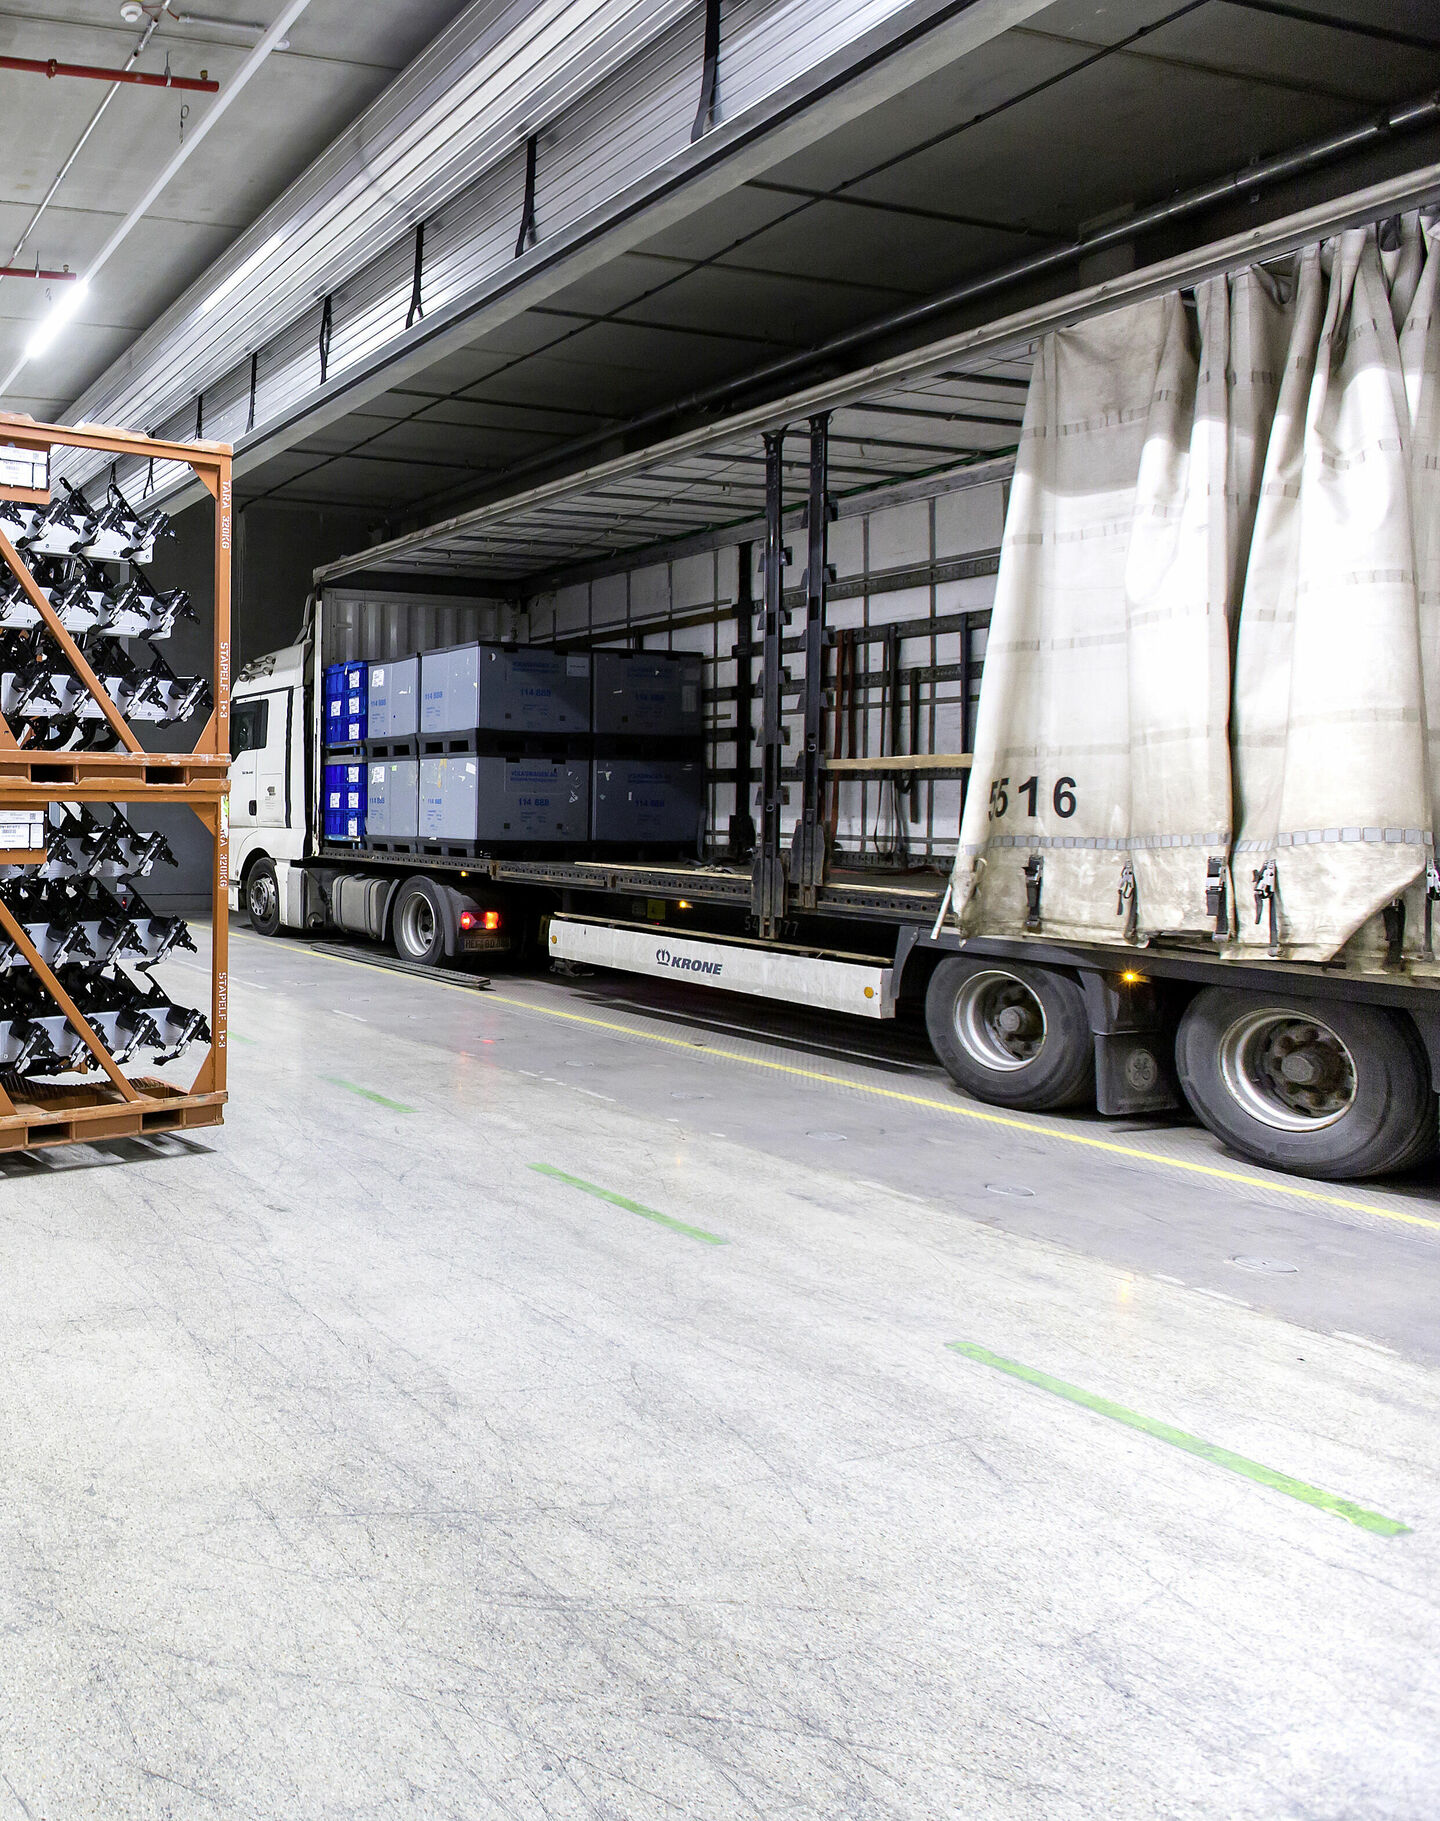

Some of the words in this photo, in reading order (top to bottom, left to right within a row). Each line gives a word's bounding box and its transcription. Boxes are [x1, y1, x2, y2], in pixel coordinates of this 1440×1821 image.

[220, 480, 231, 509] TARA
[221, 515, 230, 550] 320KG
[219, 699, 228, 718] 1+3
[519, 797, 531, 806] 114
[220, 853, 228, 888] 320KG
[671, 956, 723, 975] KRONE
[218, 1031, 227, 1048] 1+3
